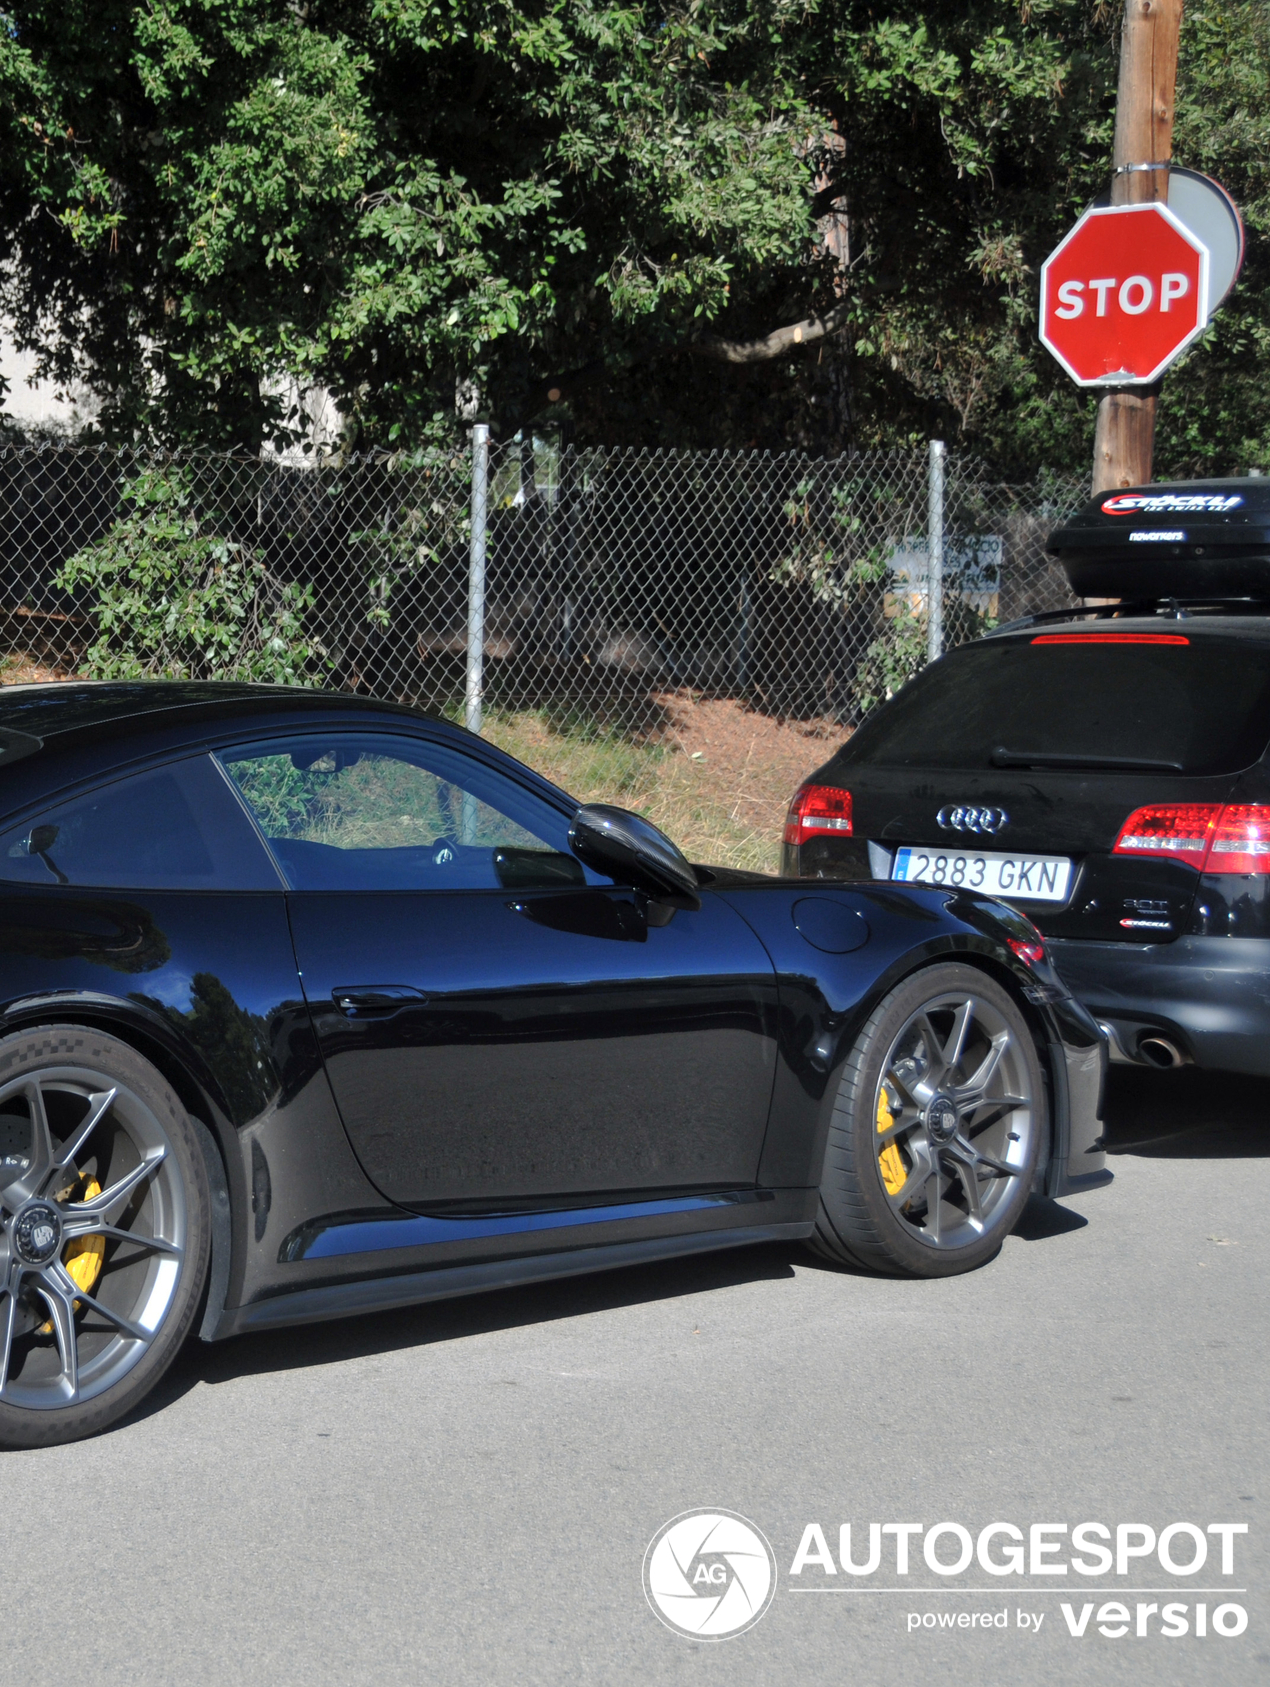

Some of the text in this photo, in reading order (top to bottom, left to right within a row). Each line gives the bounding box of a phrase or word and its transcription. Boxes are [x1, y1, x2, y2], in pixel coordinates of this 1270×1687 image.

[1054, 273, 1188, 319] STOP
[897, 871, 904, 880] E
[912, 854, 1059, 893] 2883 GKN
